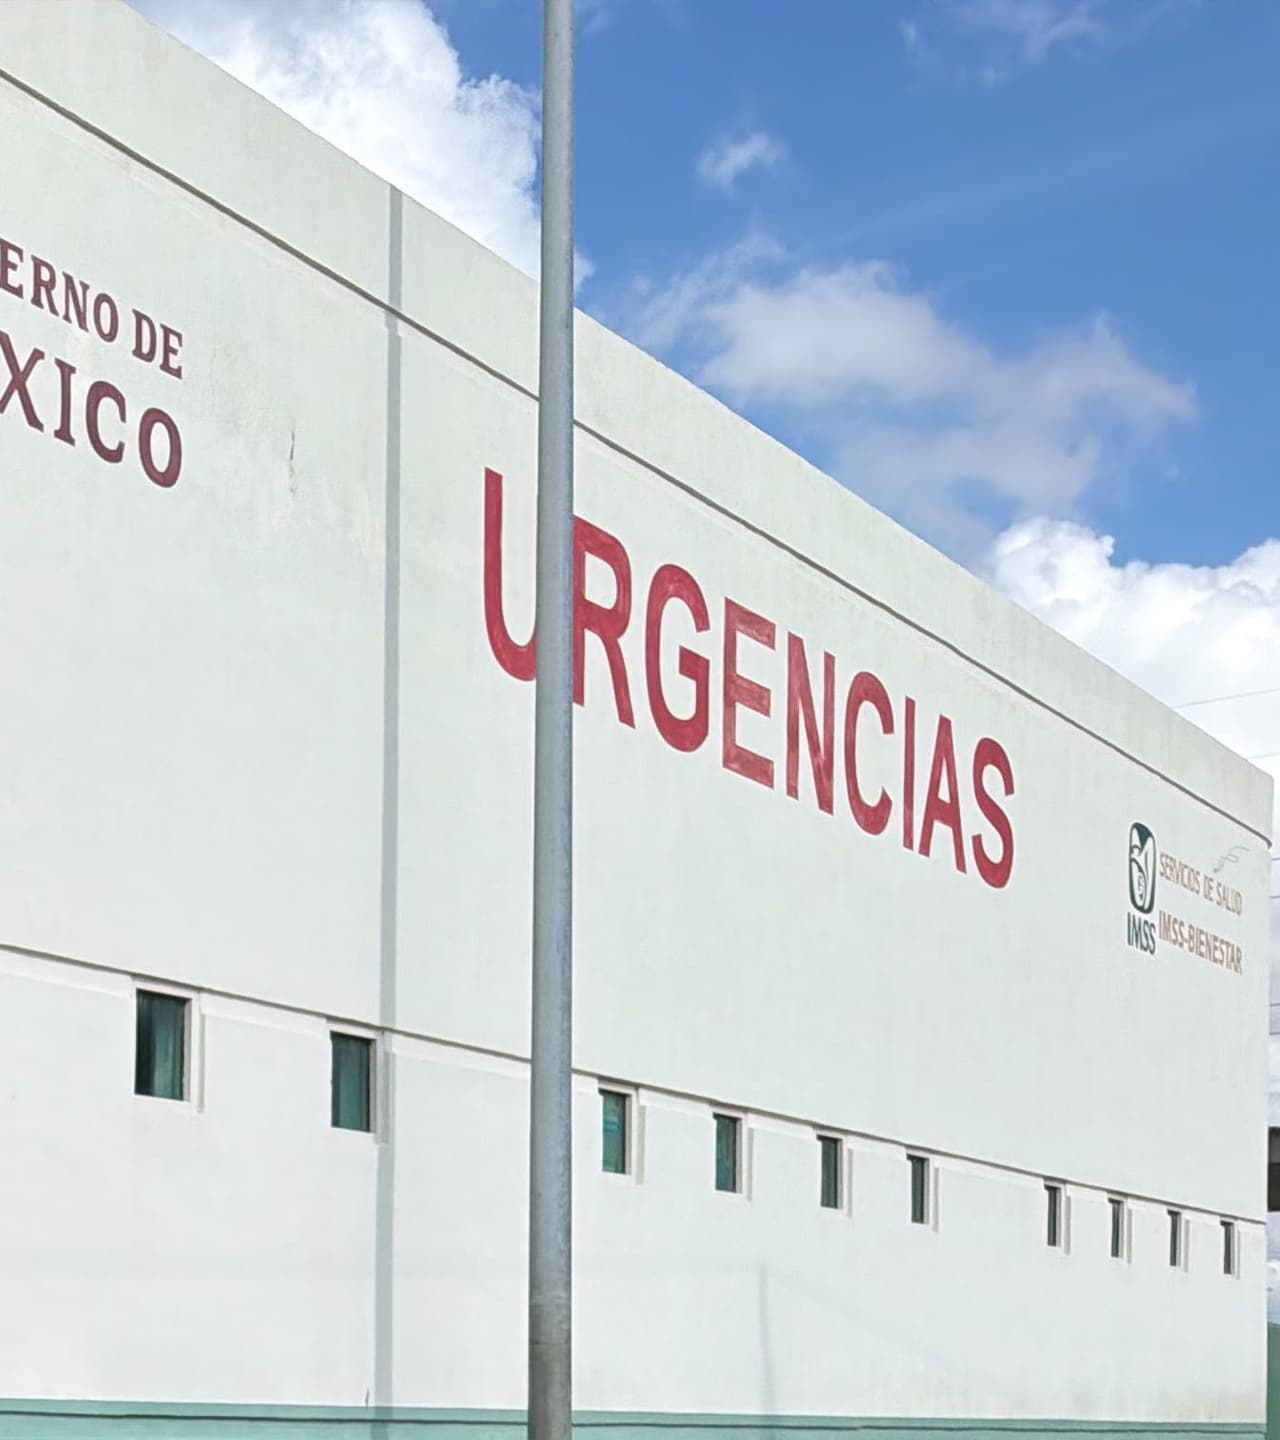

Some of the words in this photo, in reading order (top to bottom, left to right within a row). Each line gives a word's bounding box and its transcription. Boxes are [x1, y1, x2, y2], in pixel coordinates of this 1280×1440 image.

[132, 309, 183, 379] DE
[484, 466, 1015, 890] URGENCIAS
[1159, 851, 1200, 896] SERVICIOS
[1203, 874, 1214, 902] DE
[1216, 880, 1242, 916] SALUD
[1127, 911, 1156, 955] IMSS
[1158, 909, 1242, 974] IMSS-BIENESTAR
